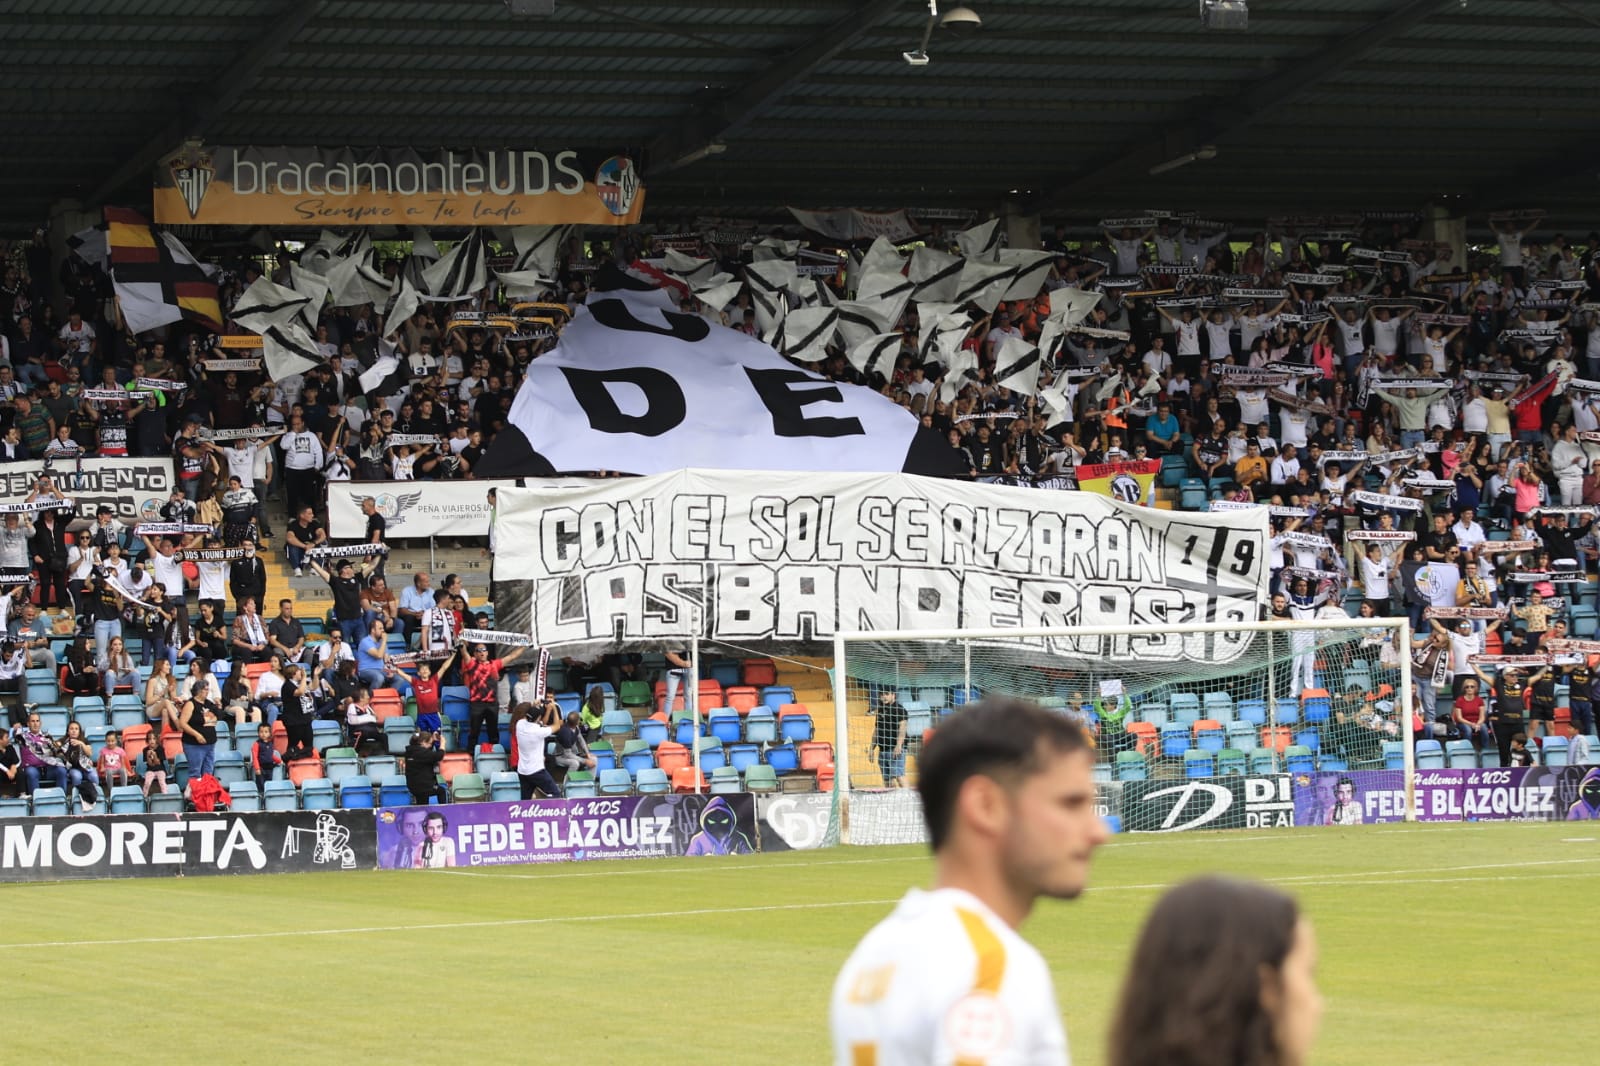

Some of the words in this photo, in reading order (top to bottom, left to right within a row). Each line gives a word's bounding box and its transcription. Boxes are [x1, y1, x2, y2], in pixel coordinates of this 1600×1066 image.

[232, 149, 585, 197] bracamonteUDS
[294, 199, 394, 222] Siempre
[406, 206, 424, 216] a
[433, 199, 458, 219] Tu
[472, 199, 524, 219] lado
[558, 366, 688, 437] D
[742, 365, 867, 438] E
[1119, 461, 1149, 474] FANS
[417, 502, 440, 513] PEÑA
[442, 503, 482, 512] VIAJEROS
[201, 549, 223, 560] YOUNG
[226, 548, 244, 559] BOYS
[540, 497, 655, 575] CON
[670, 493, 736, 562] EL
[749, 494, 843, 562] SOL
[856, 494, 929, 563] SE
[941, 502, 1166, 587] ALZARÁN
[533, 562, 706, 648] LAS
[713, 562, 1187, 662] BANDERAS
[1412, 773, 1464, 788] Hablemos
[1468, 773, 1480, 785] de
[1481, 770, 1512, 784] UDS
[509, 803, 568, 818] Hablemos
[571, 805, 585, 817] de
[586, 800, 621, 815] UDS
[1365, 789, 1424, 817] FEDE
[1431, 785, 1555, 815] BLAZQUEZ
[2, 817, 267, 870] MORETA
[458, 822, 526, 853] FEDE
[534, 816, 673, 849] BLAZQUEZ
